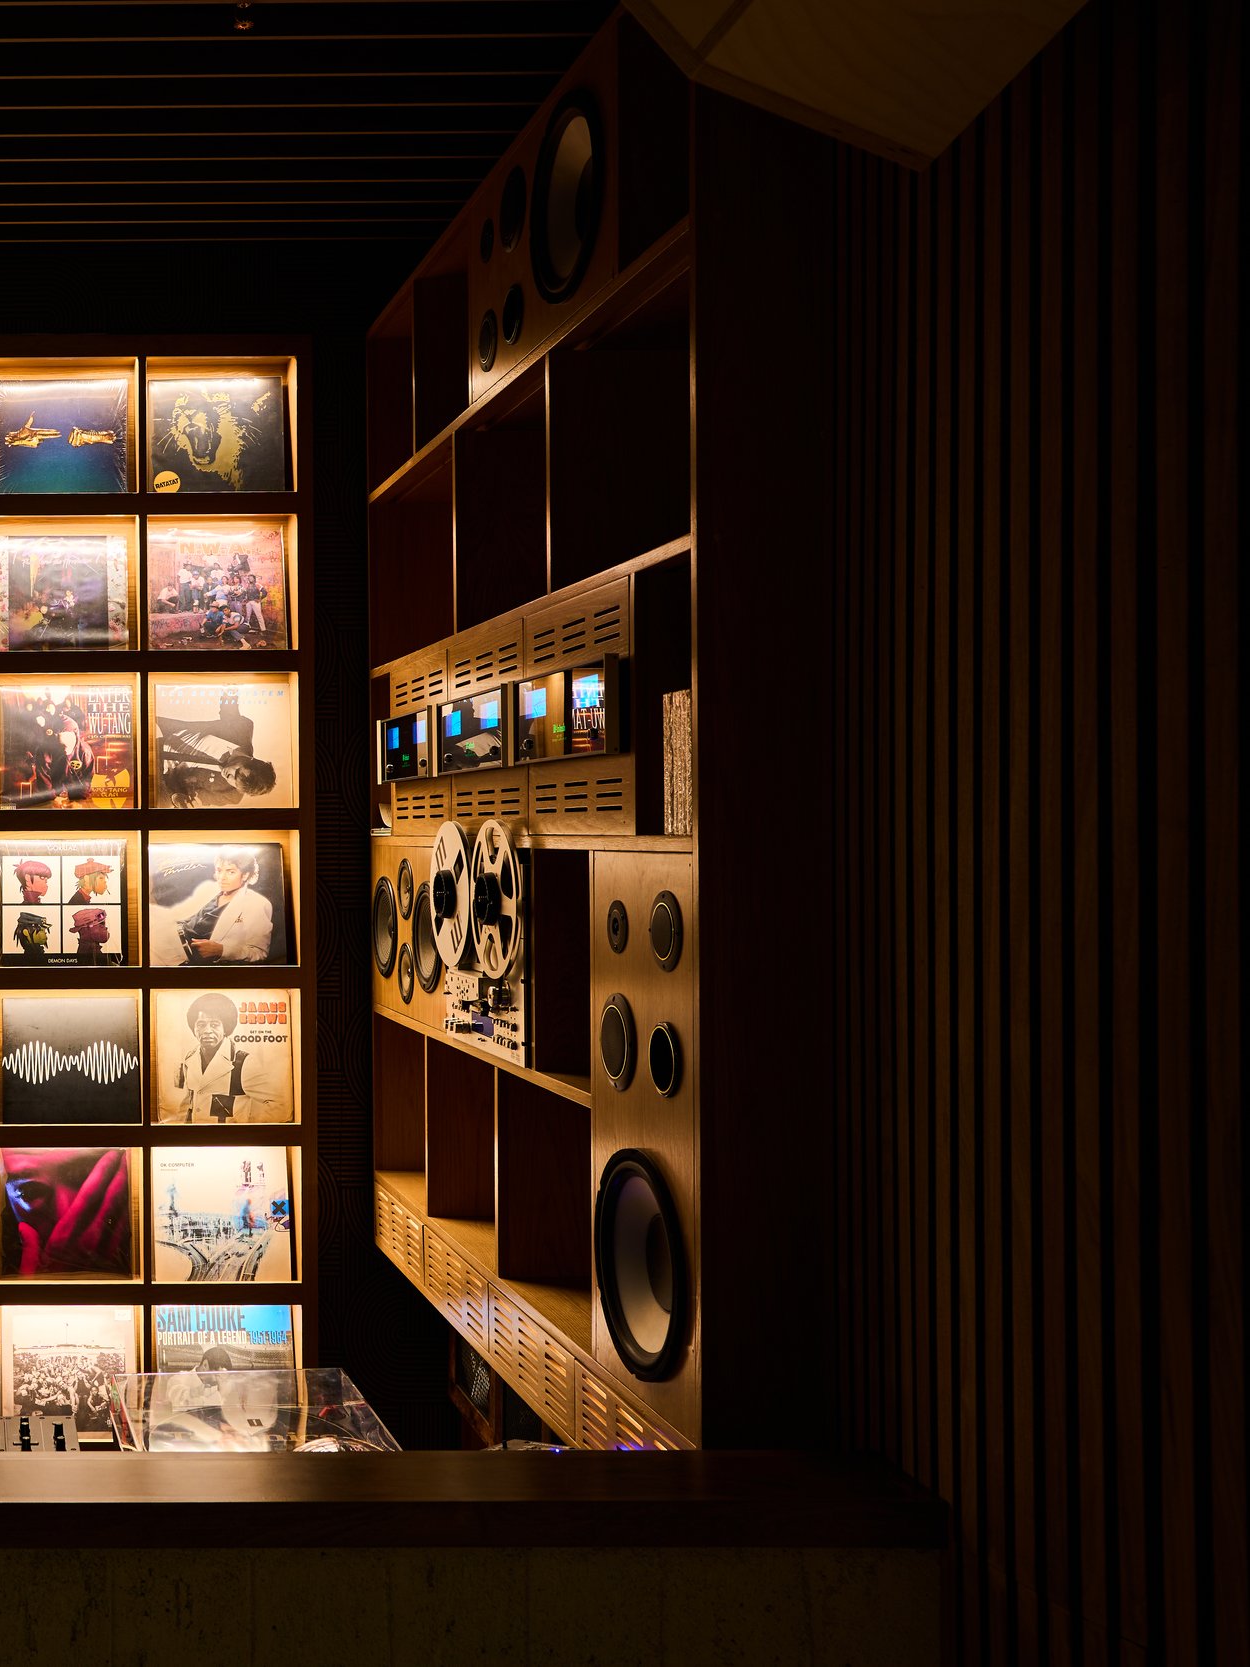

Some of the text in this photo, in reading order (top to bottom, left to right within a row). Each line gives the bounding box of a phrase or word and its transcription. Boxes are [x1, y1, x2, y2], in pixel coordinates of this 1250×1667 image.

[155, 478, 179, 490] RATATAT
[88, 686, 131, 703] ENTER
[87, 702, 130, 712] THE
[88, 713, 131, 735] WU-TANG
[239, 1001, 287, 1013] JAMES
[239, 1014, 288, 1025] BROWN
[233, 1035, 288, 1043] GOOD FOOT
[157, 1305, 192, 1332] SAM
[157, 1331, 196, 1345] PORTRAIT
[197, 1331, 208, 1345] OF
[209, 1331, 216, 1345] A
[217, 1330, 248, 1345] LEGEND
